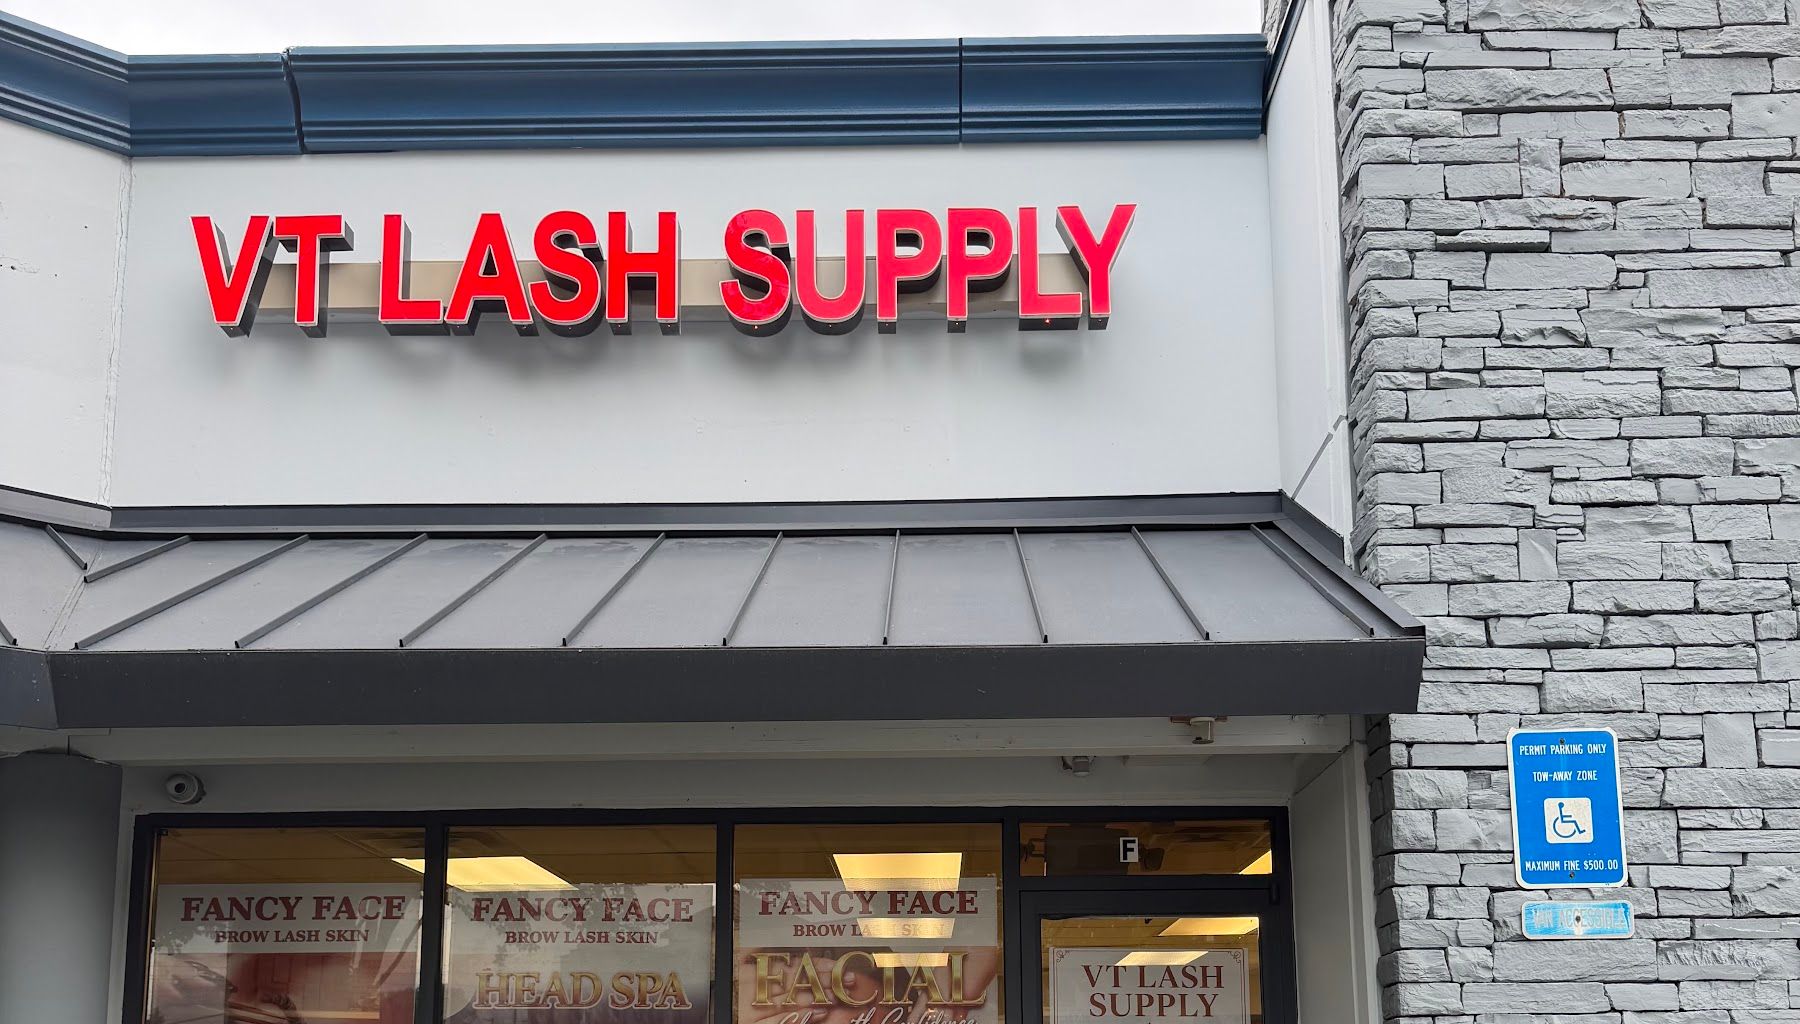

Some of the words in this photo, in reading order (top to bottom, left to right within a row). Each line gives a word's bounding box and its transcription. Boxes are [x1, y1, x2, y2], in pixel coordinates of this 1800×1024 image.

[190, 213, 346, 329] VT
[378, 210, 679, 328] LASH
[718, 203, 1138, 322] SUPPLY
[1519, 745, 1547, 756] PERMIT
[1550, 744, 1583, 755] PARKING
[1587, 743, 1607, 754] ONLY
[1532, 771, 1573, 782] TOW-AWAY
[1577, 770, 1598, 781] ZONE
[1121, 838, 1137, 861] F
[1525, 860, 1560, 871] MAXIMUM
[1564, 860, 1580, 871] FINE
[1584, 859, 1619, 871] $500.00
[180, 895, 304, 922] FANCY
[311, 895, 406, 921] FACE
[470, 897, 593, 922] FANCY
[601, 897, 694, 922] FACE
[758, 890, 878, 916] FANCY
[887, 889, 979, 915] FACE
[214, 930, 270, 944] BROW
[273, 929, 321, 943] LASH
[325, 929, 370, 943] SKIN
[504, 931, 560, 944] BROW
[564, 931, 611, 944] LASH
[615, 931, 659, 944] SKIN
[792, 924, 847, 937] BROW
[752, 950, 987, 1008] FACIAL
[1081, 964, 1127, 989] VT
[1138, 964, 1225, 989] LASH
[472, 970, 603, 1010] HEAD
[608, 970, 693, 1010] SPA
[1089, 992, 1219, 1018] SUPPLY
